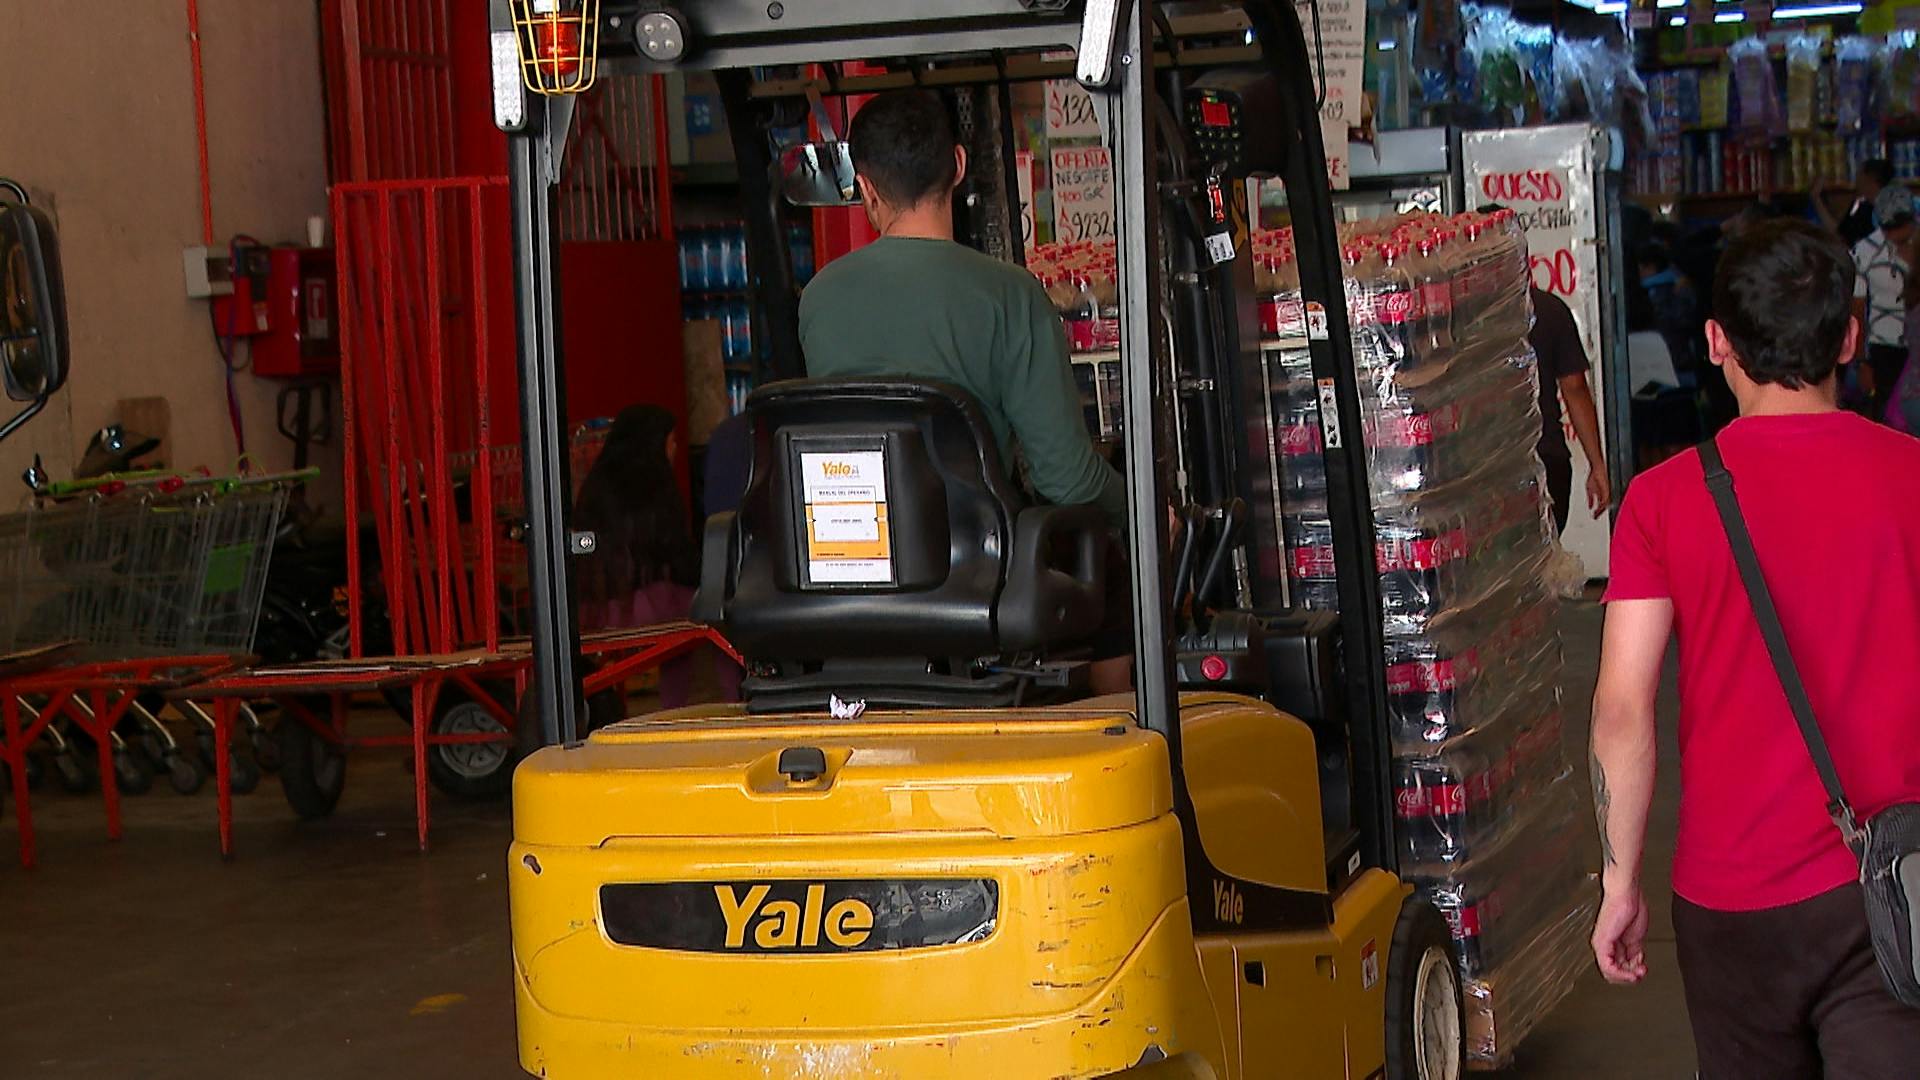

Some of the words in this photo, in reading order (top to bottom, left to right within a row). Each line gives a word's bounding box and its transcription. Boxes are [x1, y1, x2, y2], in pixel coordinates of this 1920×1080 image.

[1482, 168, 1562, 202] QUESO
[714, 884, 875, 949] Yale
[1212, 879, 1245, 925] Yale
